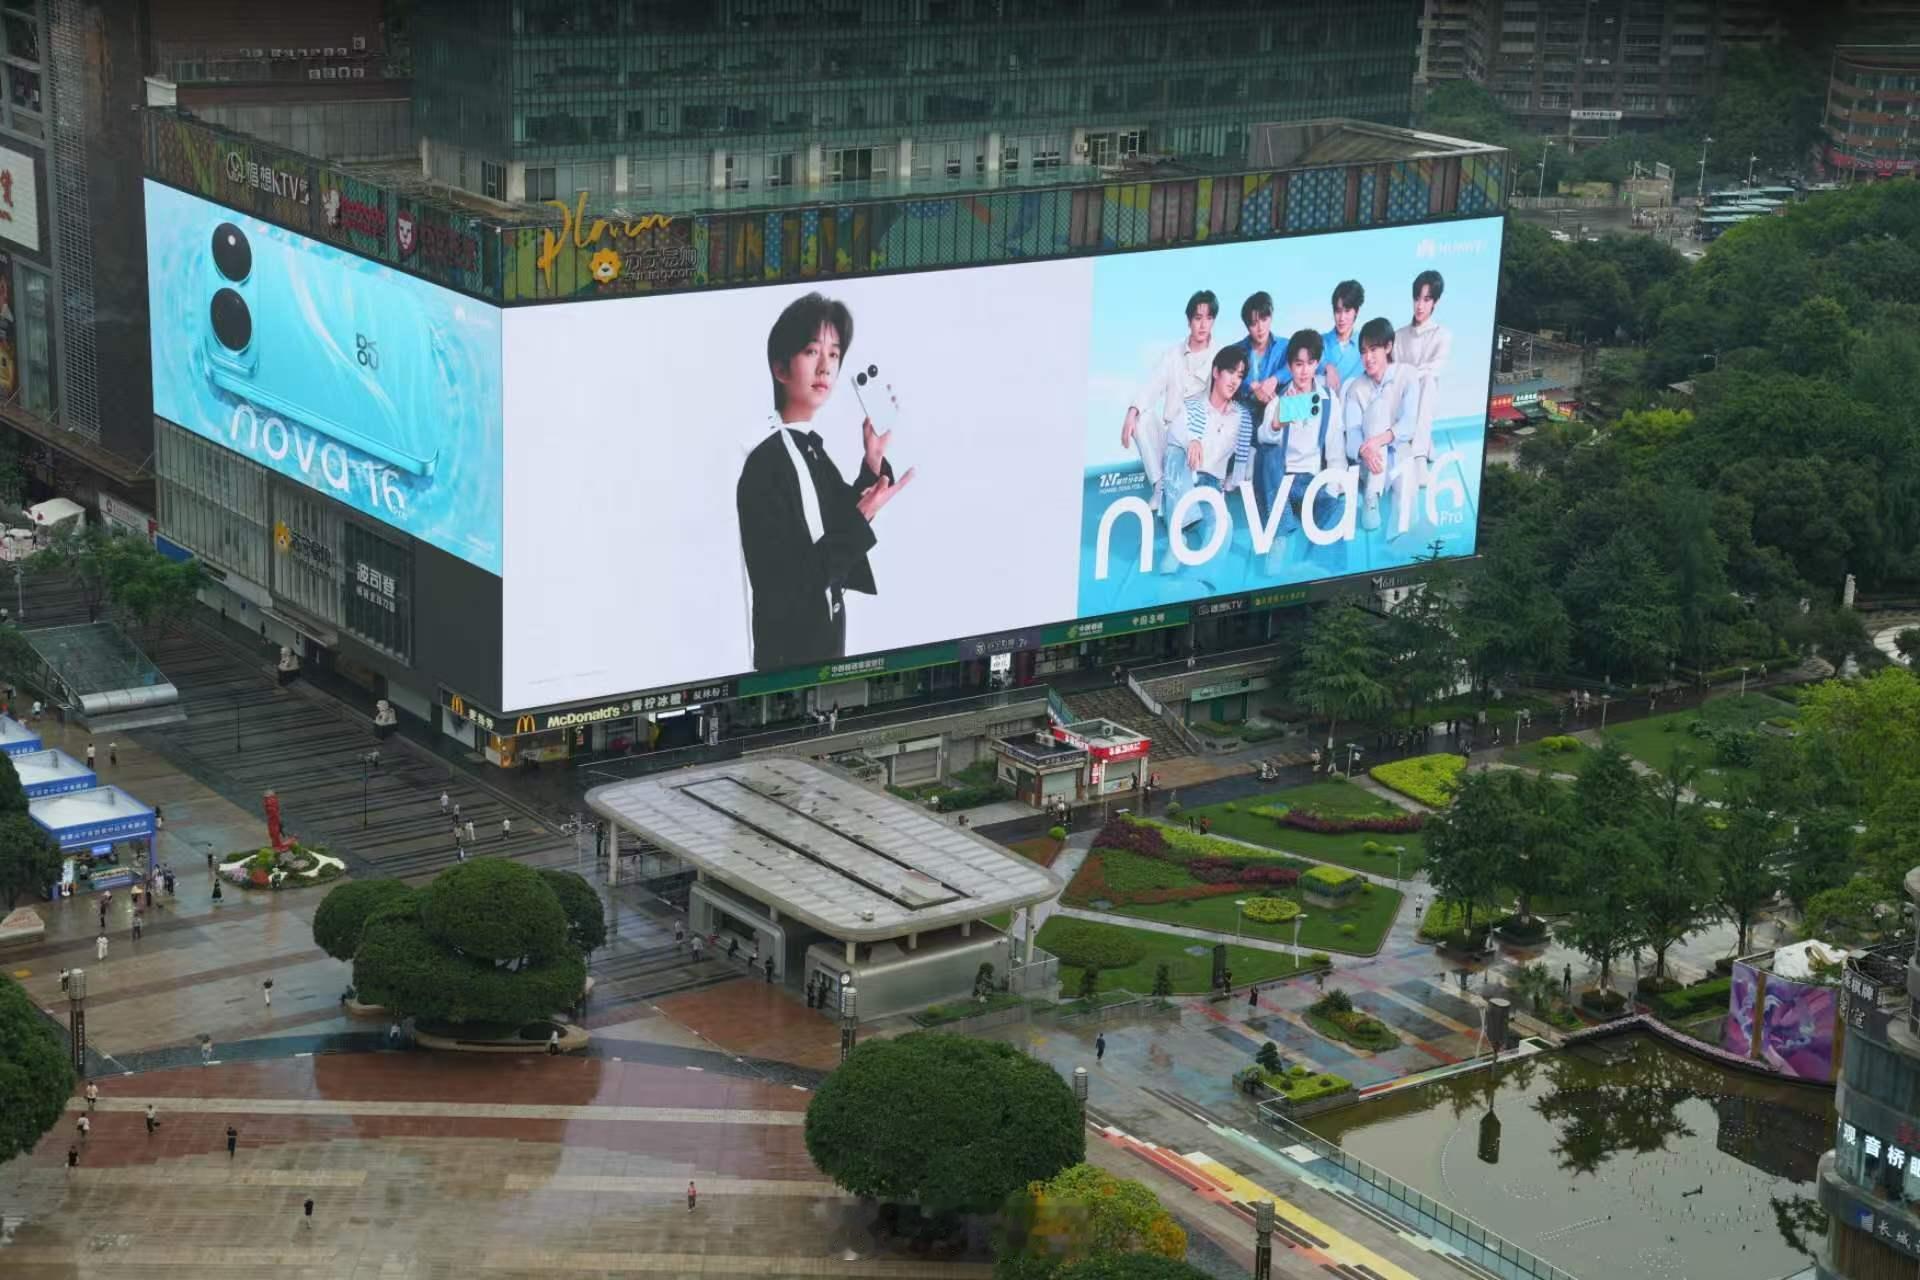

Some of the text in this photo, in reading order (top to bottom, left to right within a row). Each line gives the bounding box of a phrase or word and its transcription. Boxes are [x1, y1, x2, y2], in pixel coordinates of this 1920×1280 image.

[230, 403, 350, 494] nova
[1095, 451, 1466, 580] nova 16
[356, 561, 396, 599] 波司登
[547, 705, 621, 729] McDonald's
